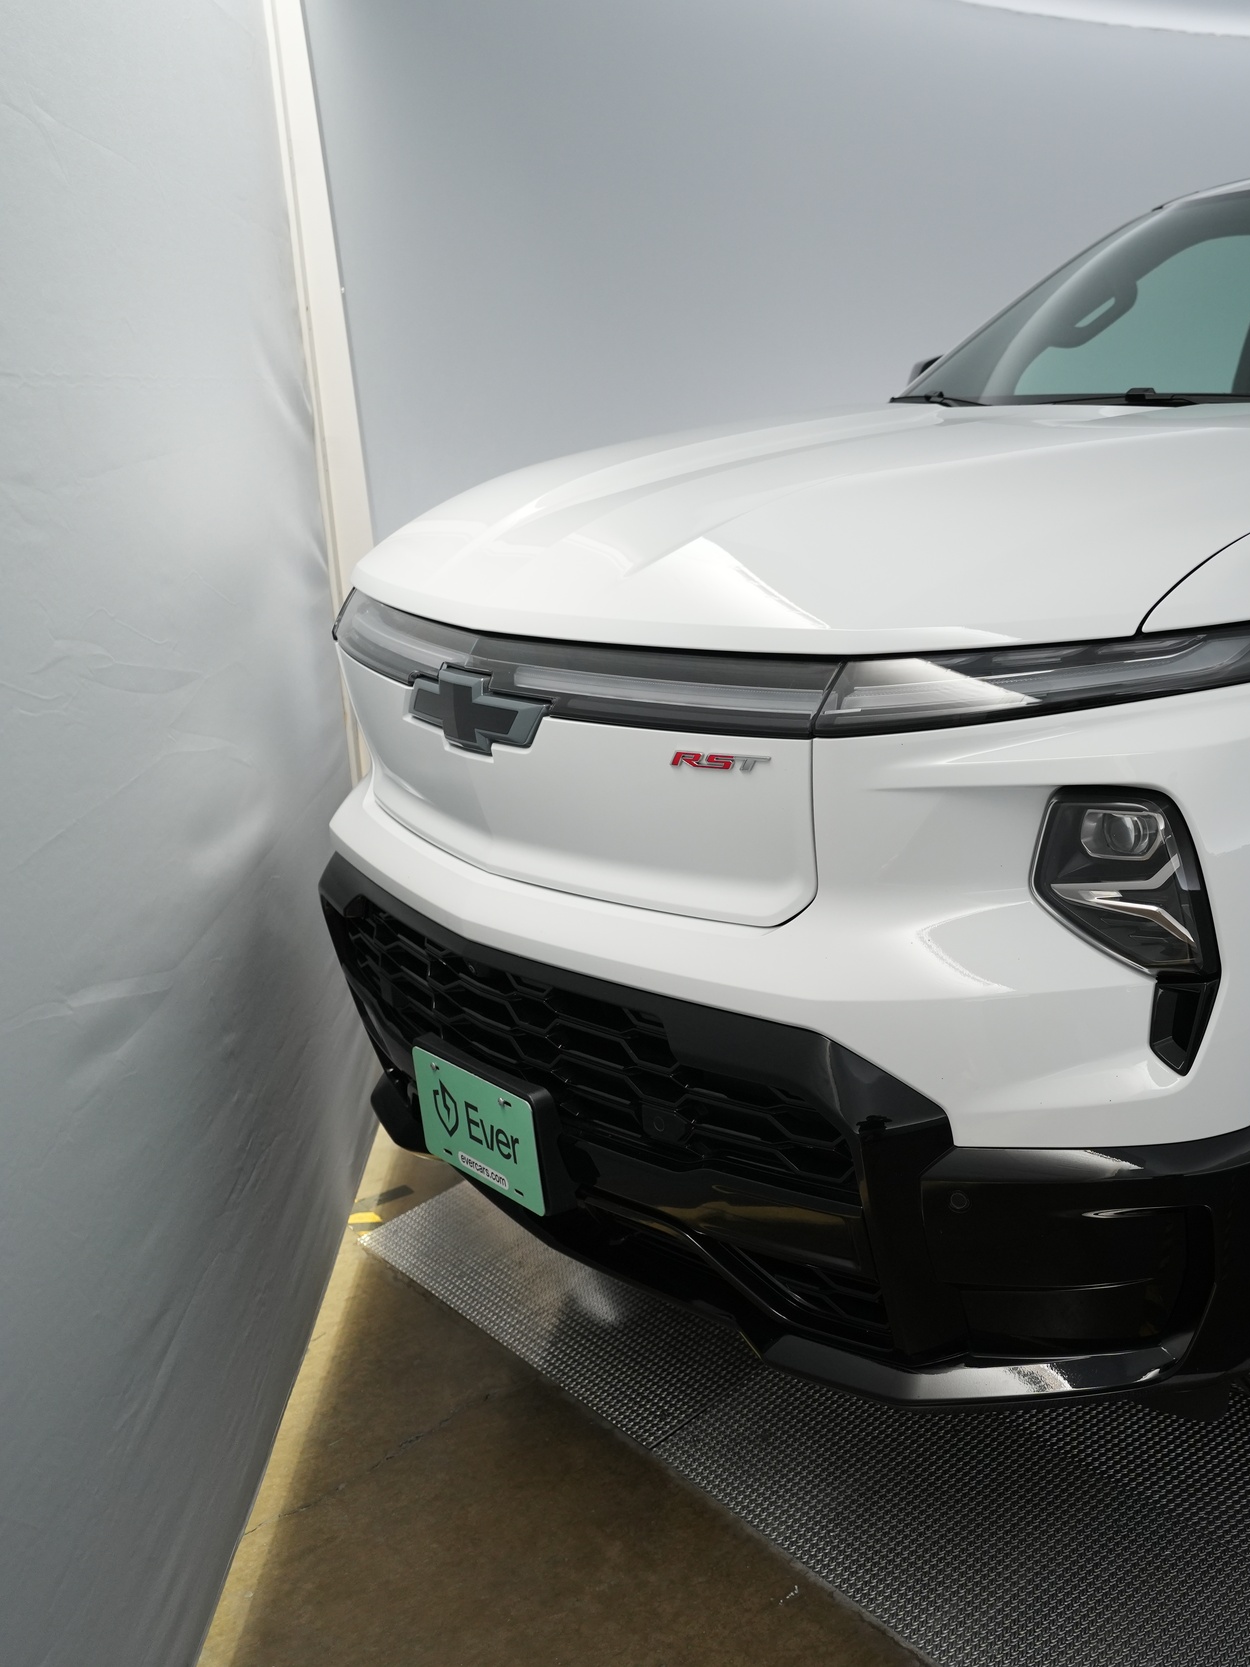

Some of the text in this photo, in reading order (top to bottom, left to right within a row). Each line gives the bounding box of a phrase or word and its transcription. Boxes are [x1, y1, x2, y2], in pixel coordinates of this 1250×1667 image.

[670, 750, 772, 772] RST
[464, 1101, 519, 1164] Ever
[460, 1154, 507, 1187] evercars.com
